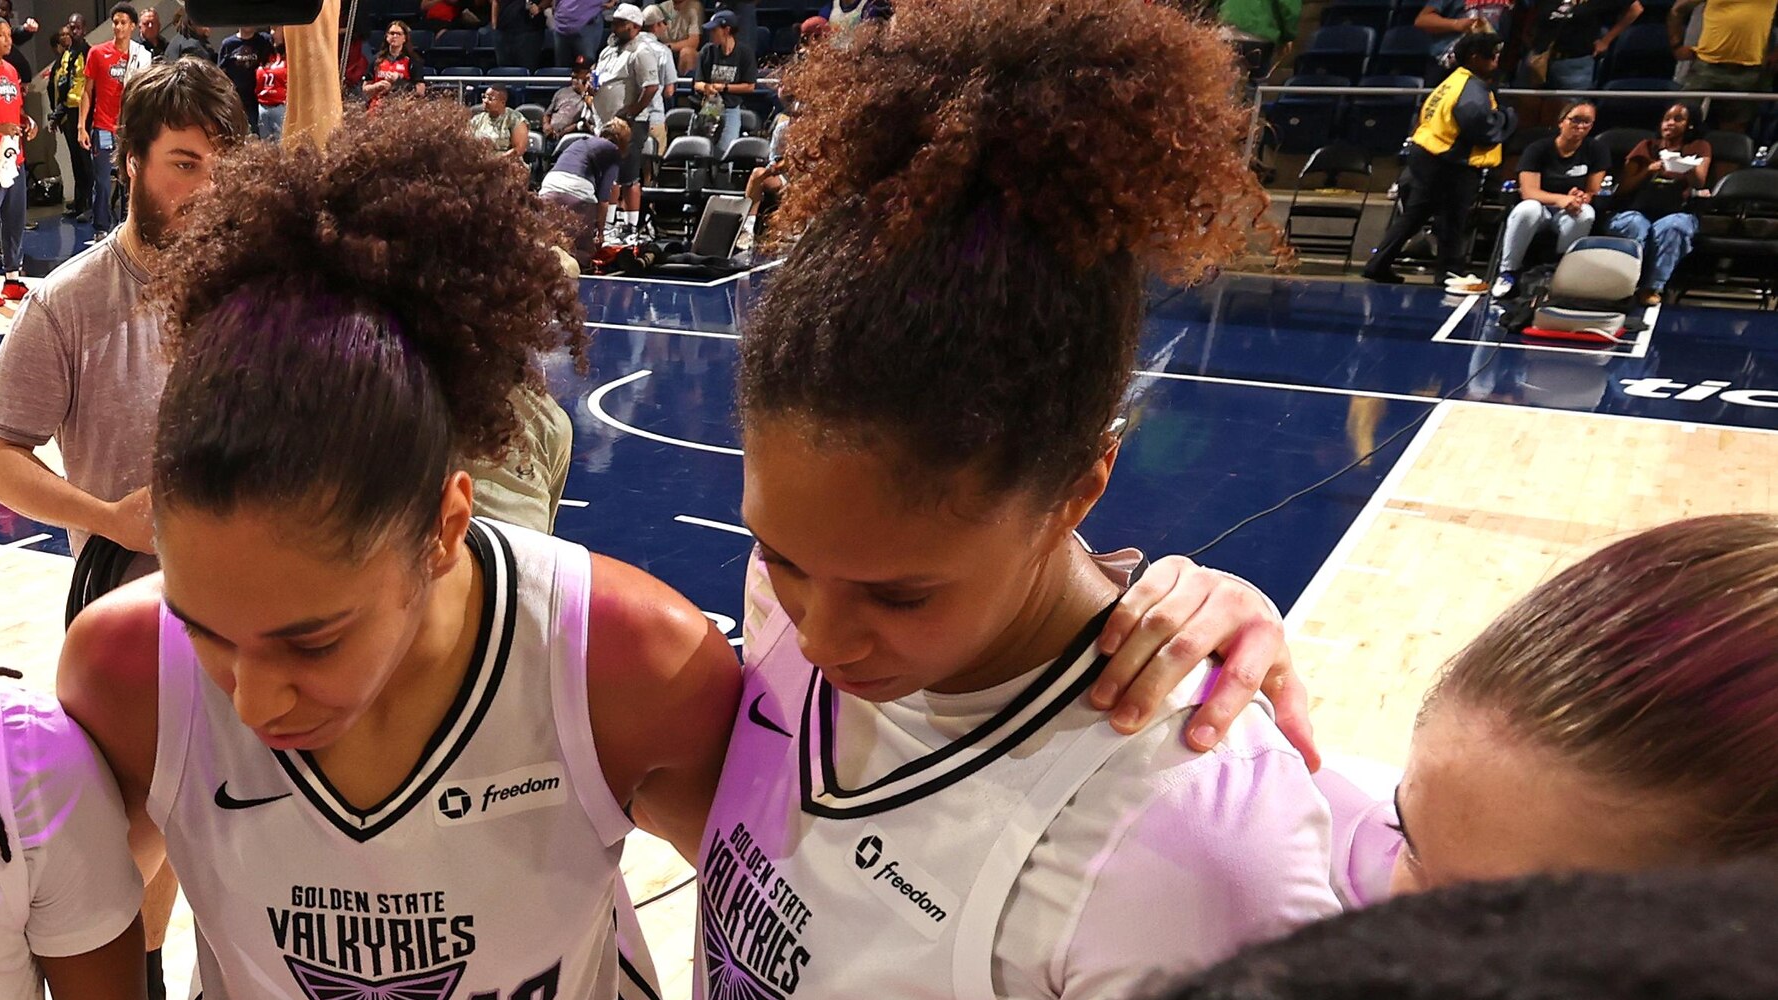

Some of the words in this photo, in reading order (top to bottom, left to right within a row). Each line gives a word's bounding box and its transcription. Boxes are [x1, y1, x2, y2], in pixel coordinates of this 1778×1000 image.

[481, 775, 560, 811] freedom
[291, 885, 369, 913] GOLDEN
[377, 891, 445, 914] STATE
[729, 822, 773, 887] GOLDEN
[769, 875, 813, 934] STATE
[873, 861, 947, 924] freedom
[266, 907, 476, 976] VALKYRIES
[703, 828, 812, 995] VALKYRIES
